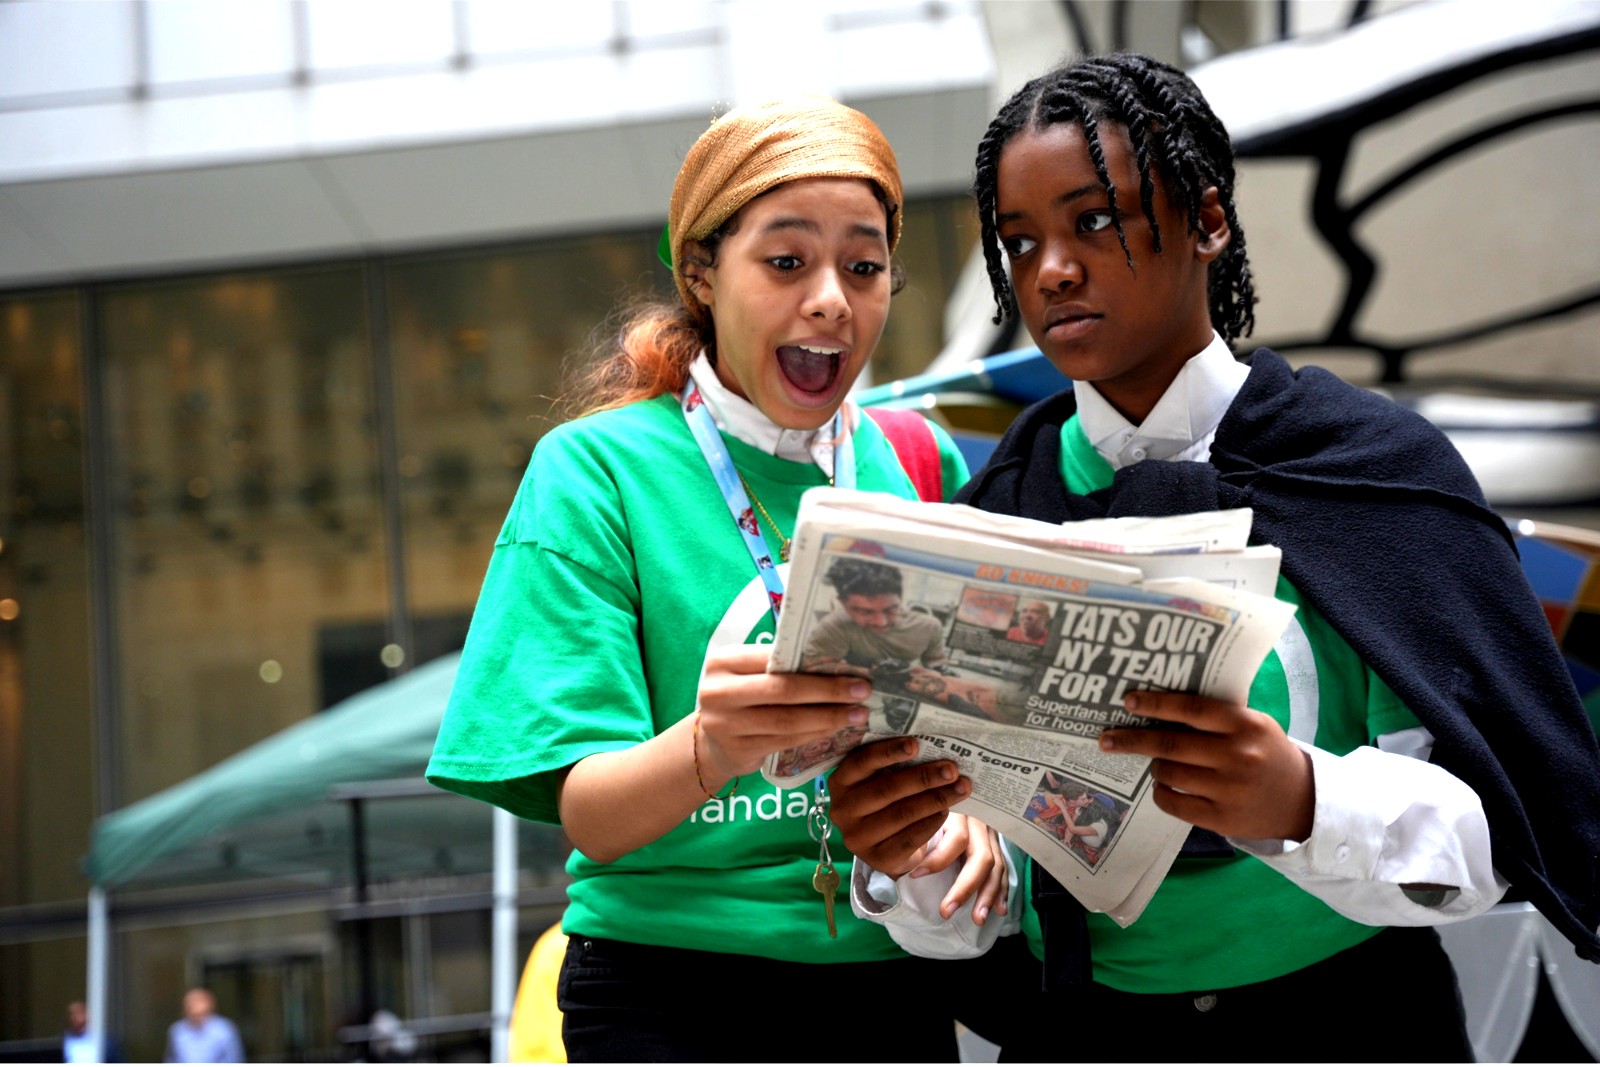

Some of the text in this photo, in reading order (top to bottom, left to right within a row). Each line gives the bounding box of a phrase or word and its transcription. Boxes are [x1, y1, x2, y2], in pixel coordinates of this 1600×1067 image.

[976, 563, 1090, 594] GO KNICKS!
[1060, 602, 1141, 647] TATS
[1144, 612, 1216, 653] OUR
[1053, 639, 1104, 672] NY
[1106, 648, 1196, 692] TEAM
[1038, 666, 1108, 704] FOR
[1025, 711, 1051, 726] for
[1026, 695, 1108, 722] Superfans
[950, 743, 972, 758] up
